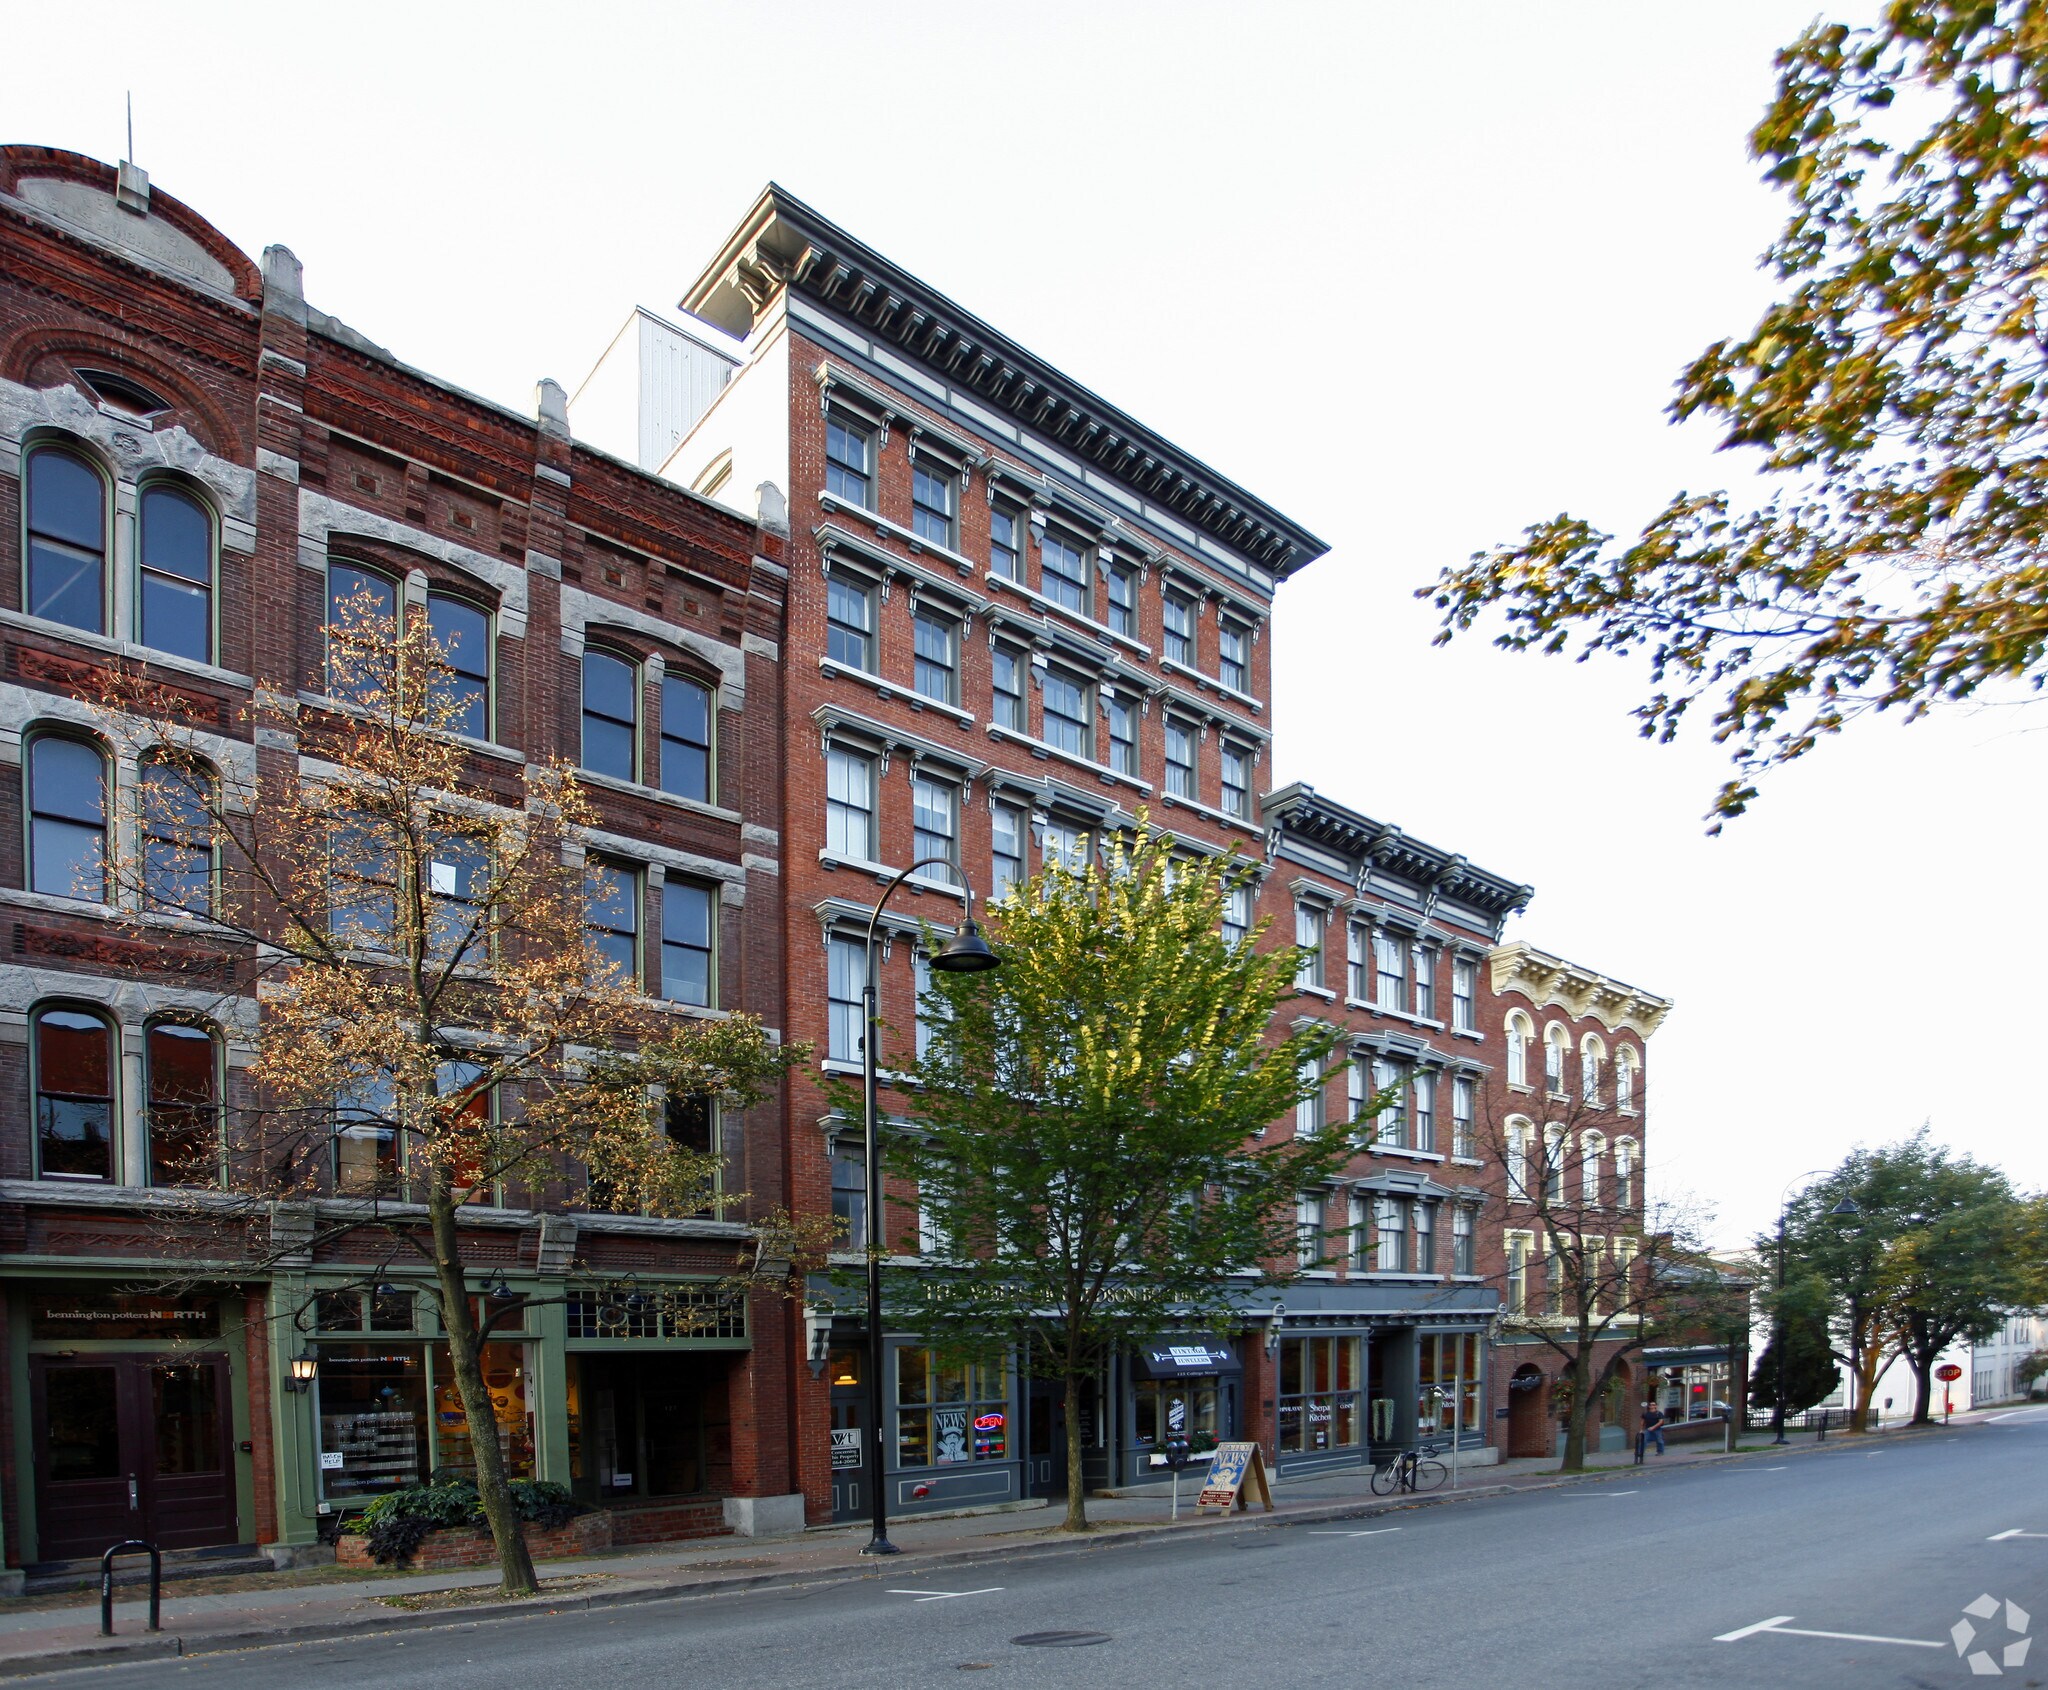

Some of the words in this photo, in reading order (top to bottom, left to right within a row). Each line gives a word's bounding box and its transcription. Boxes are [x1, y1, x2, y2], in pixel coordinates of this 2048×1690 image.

[47, 1310, 110, 1320] bennington
[111, 1311, 149, 1320] potters
[1936, 1369, 1961, 1377] STOP
[1308, 1403, 1331, 1413] Sherpa
[935, 1412, 967, 1430] NEWS
[974, 1417, 1002, 1427] OPEN
[1309, 1413, 1332, 1422] Kitchen
[1213, 1451, 1248, 1465] NEWS
